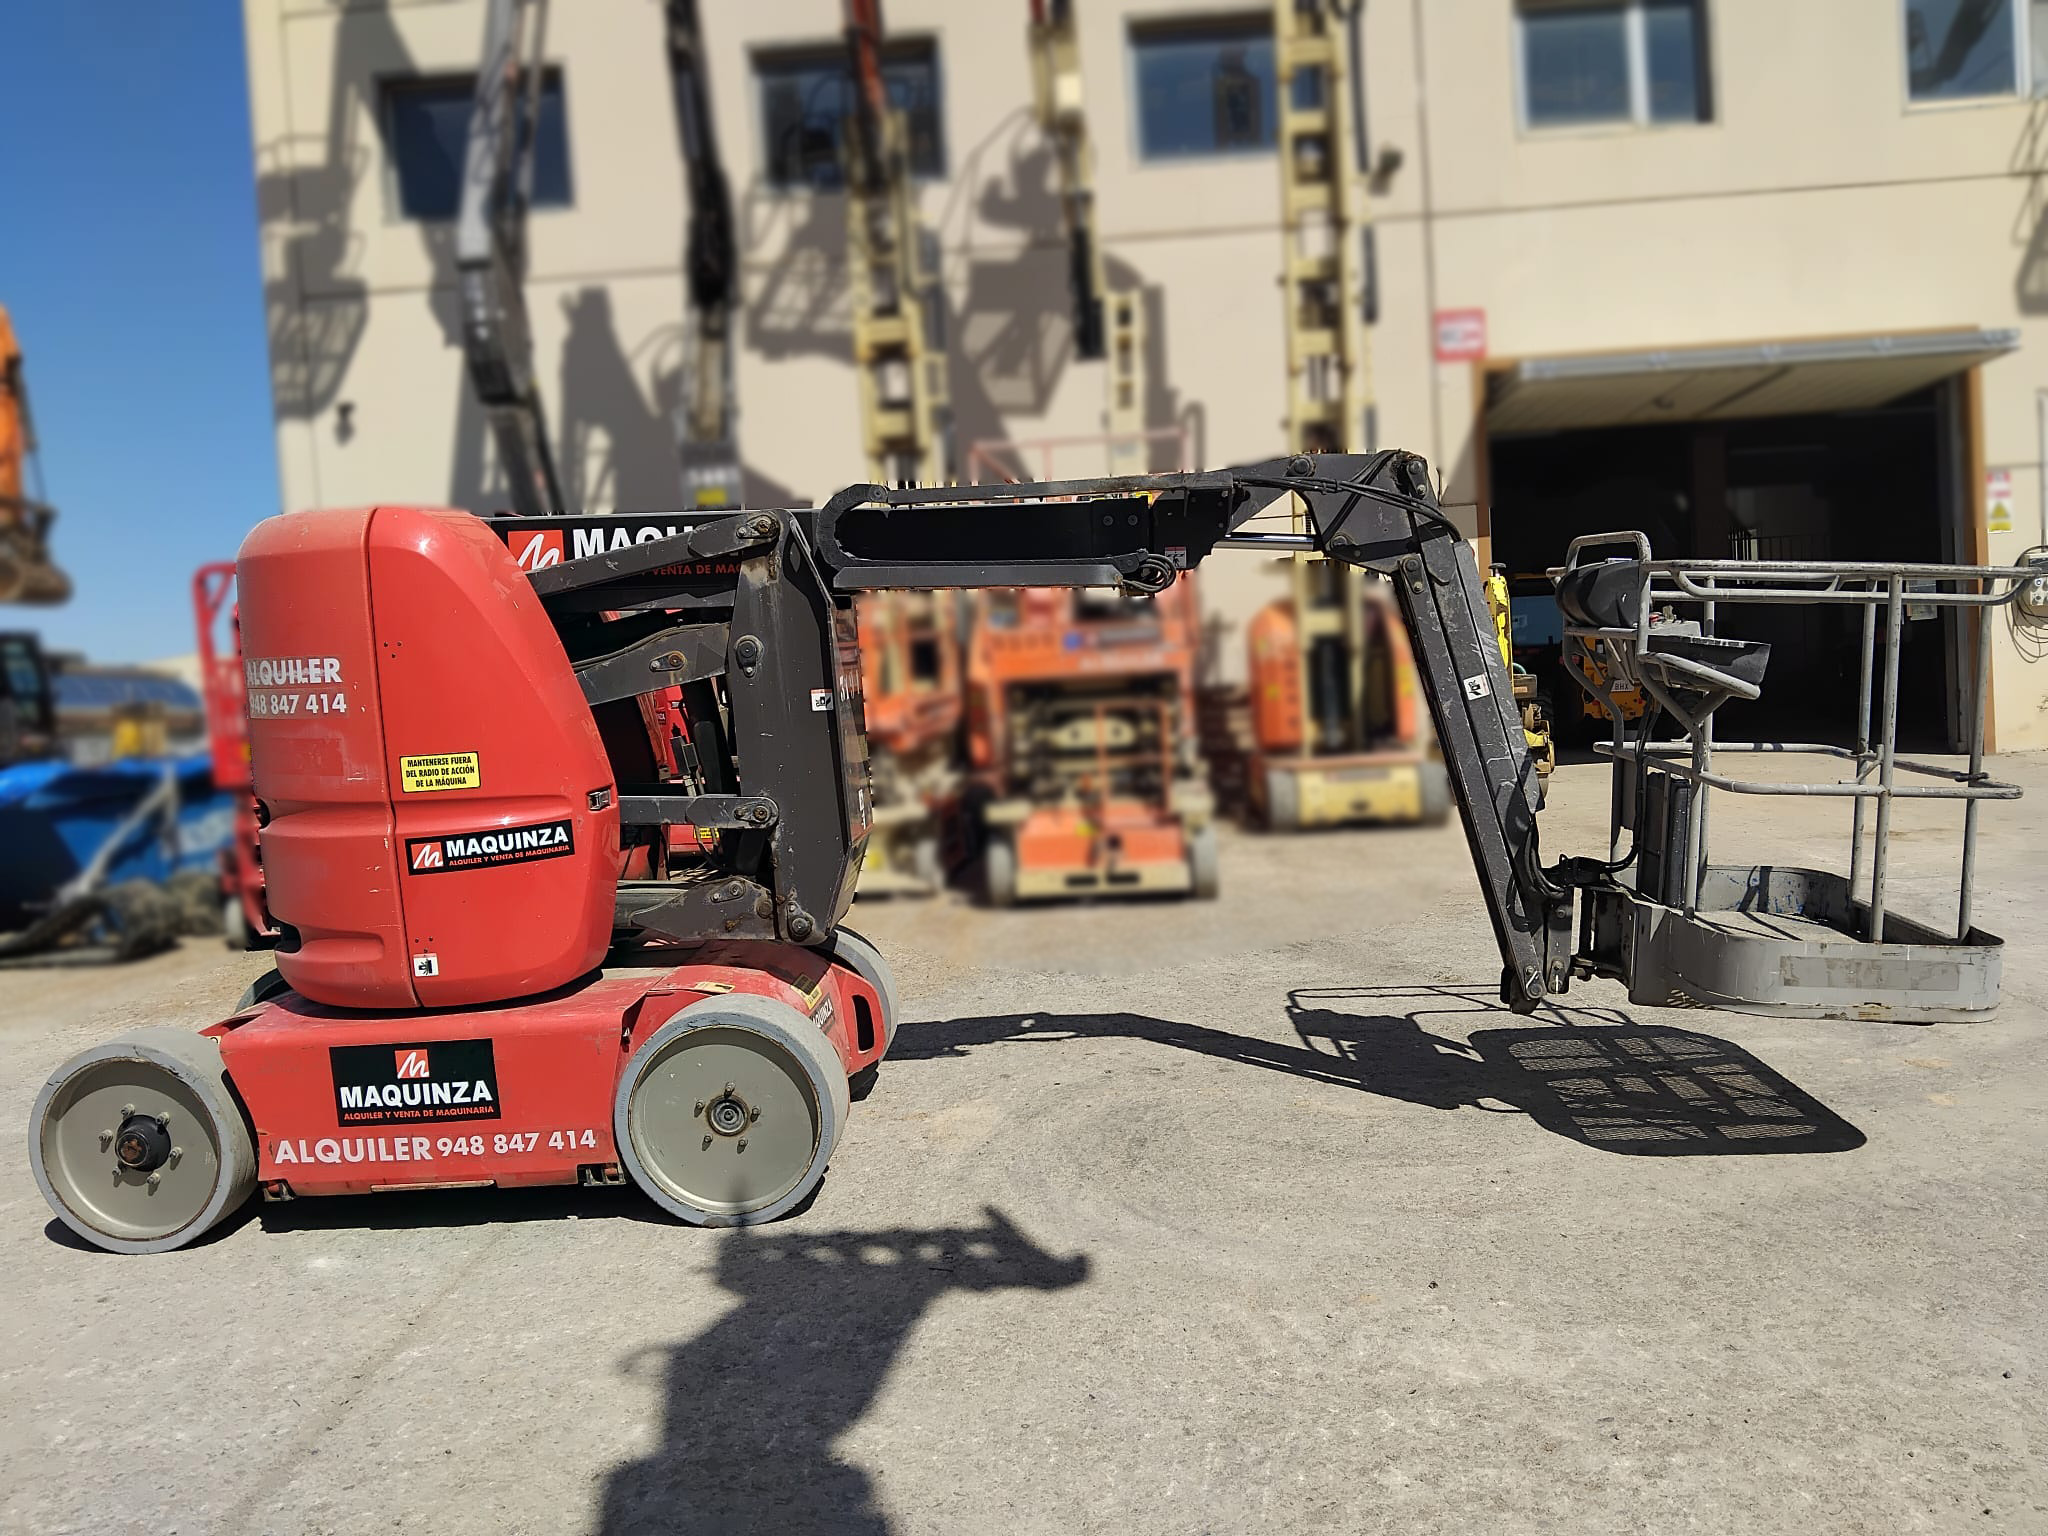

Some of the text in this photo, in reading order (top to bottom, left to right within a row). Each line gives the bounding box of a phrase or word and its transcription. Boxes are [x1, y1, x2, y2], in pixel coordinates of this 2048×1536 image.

[696, 564, 712, 575] DE
[247, 658, 343, 686] ALQUILER
[270, 694, 300, 715] 847
[305, 693, 347, 714] 414
[405, 769, 417, 778] DEL
[418, 768, 440, 777] RADIO
[441, 767, 450, 776] DE
[407, 756, 472, 767] MANTENERSE FUERA
[415, 779, 425, 788] DE
[426, 778, 434, 787] LA
[446, 826, 569, 857] MAQUINZA
[449, 857, 482, 866] ALQUILER
[491, 854, 514, 862] VENTA
[525, 844, 570, 857] MAQUINARIA
[339, 1080, 493, 1109] MAQUINZA
[344, 1112, 383, 1120] ALQUILER
[394, 1110, 421, 1118] VENTA
[423, 1109, 434, 1117] DE
[436, 1106, 494, 1116] MAQUINARIA
[274, 1129, 597, 1164] ALQUILER 948 847 414
